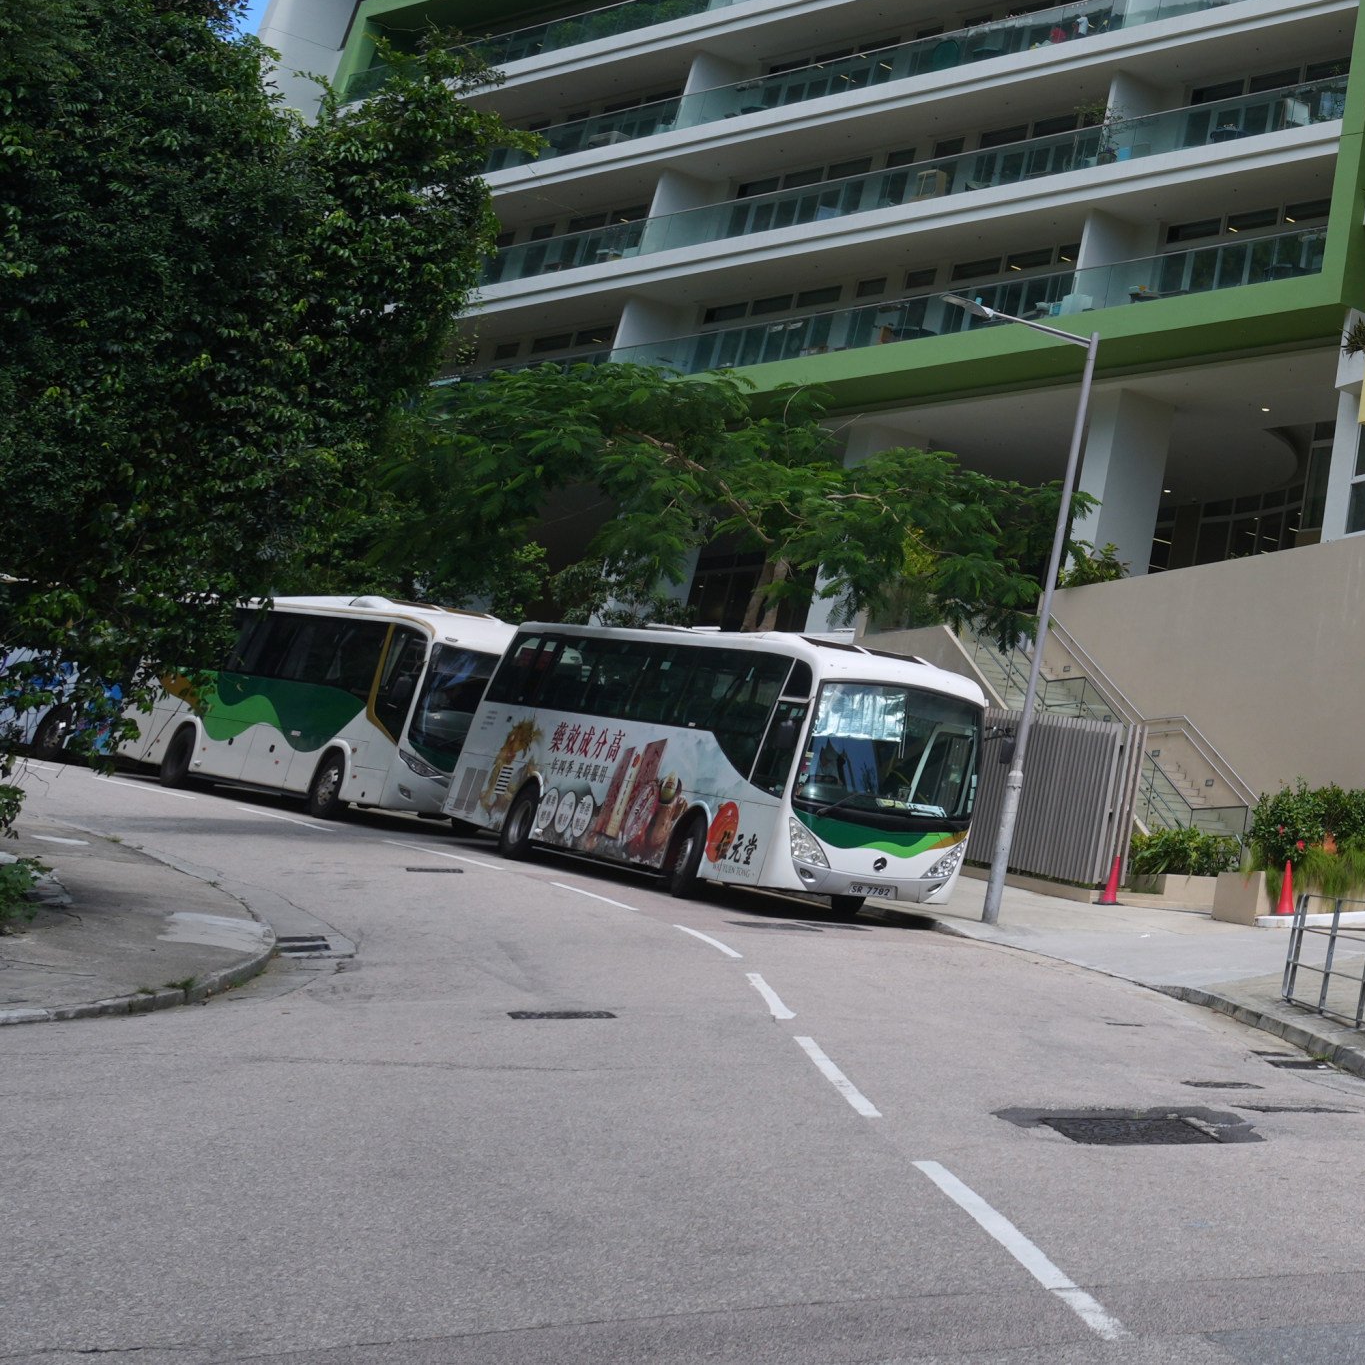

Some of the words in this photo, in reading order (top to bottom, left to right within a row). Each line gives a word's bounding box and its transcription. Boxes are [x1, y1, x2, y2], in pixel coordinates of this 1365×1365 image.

[548, 721, 626, 763] 藥效成分高
[852, 885, 863, 894] SR
[866, 886, 890, 896] 7782
